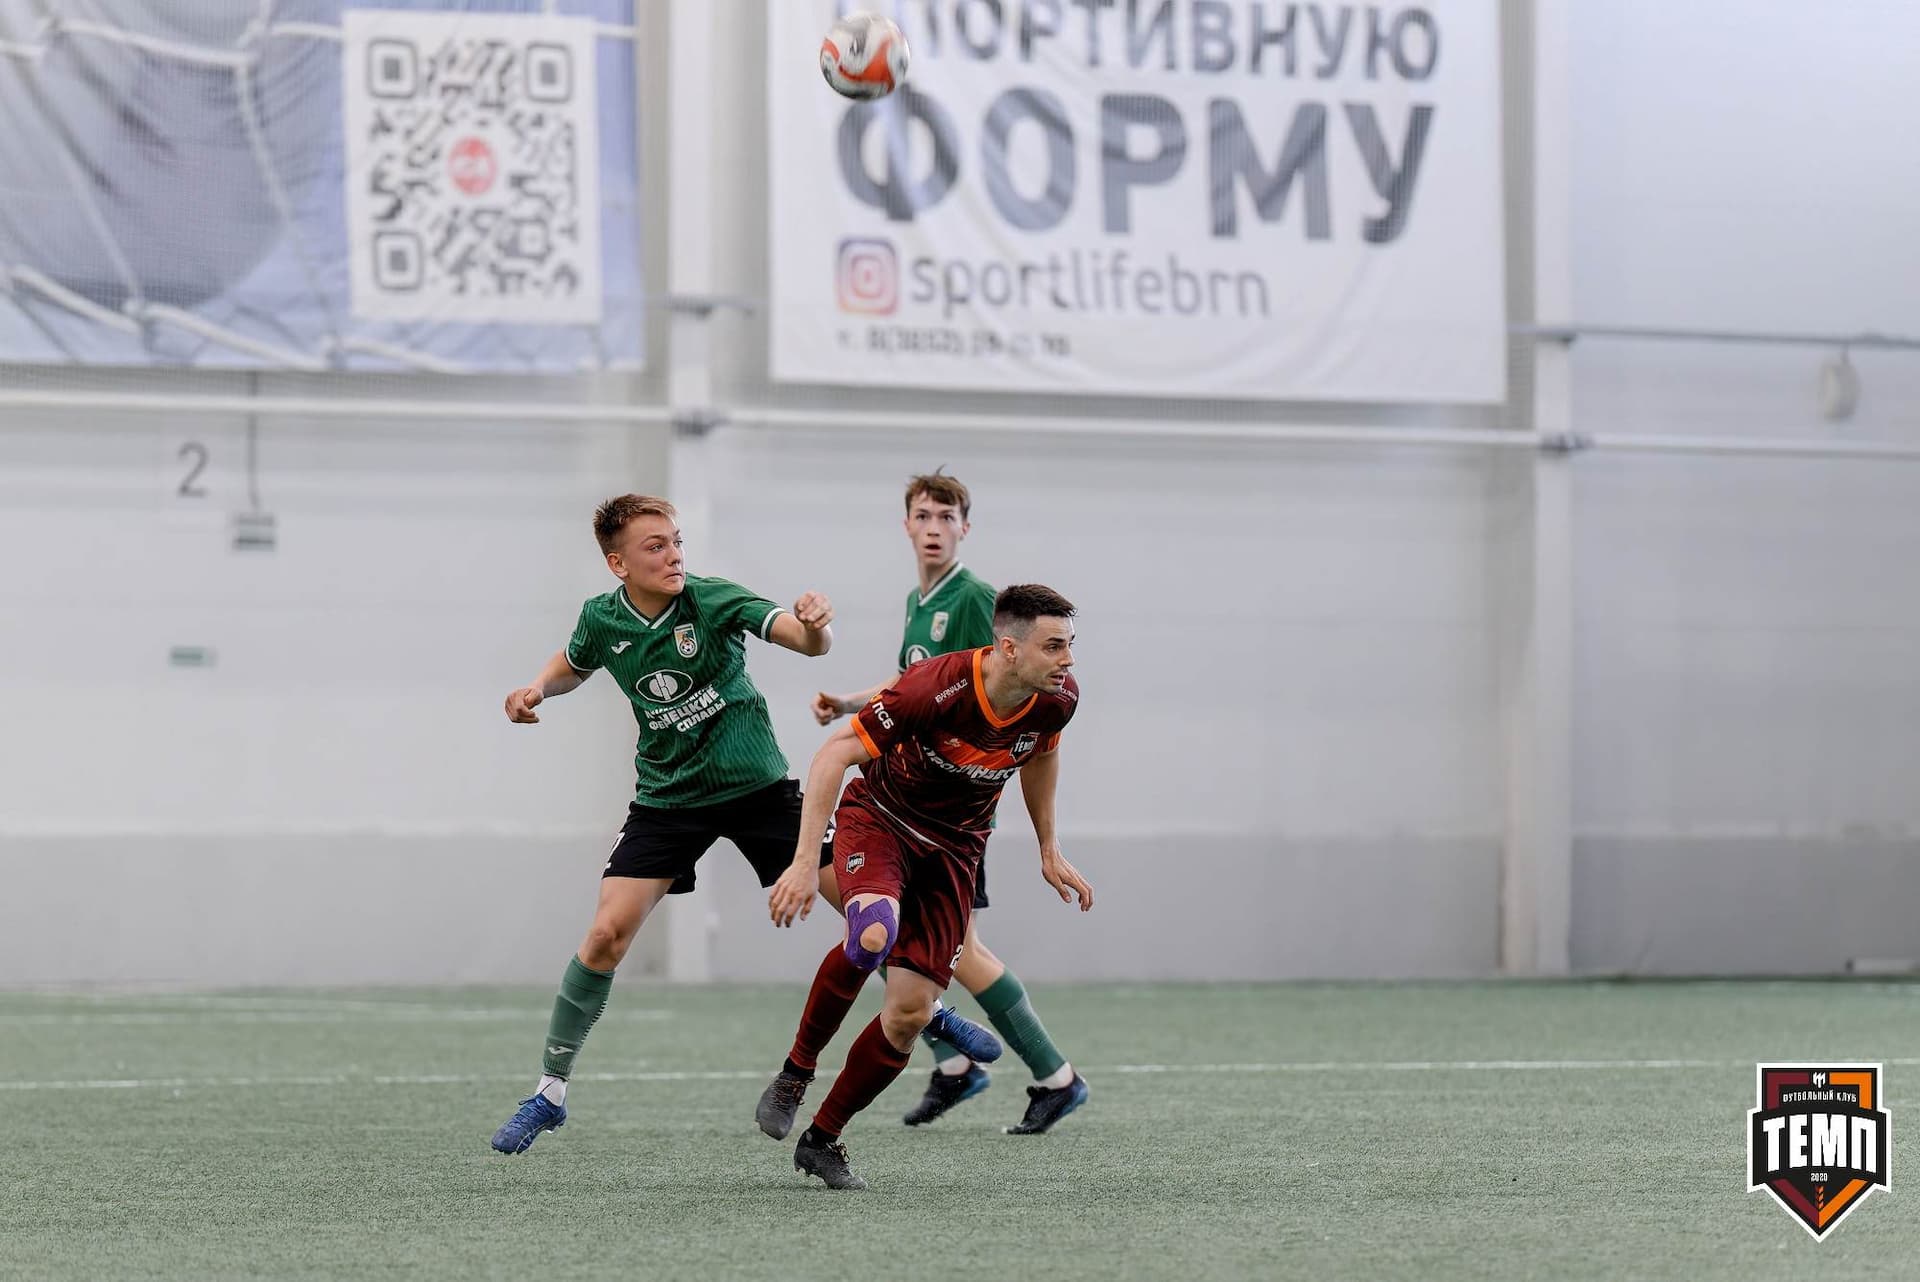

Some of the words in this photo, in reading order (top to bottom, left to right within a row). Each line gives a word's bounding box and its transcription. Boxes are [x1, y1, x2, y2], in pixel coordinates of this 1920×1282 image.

[836, 0, 1440, 80] ОРТИВНУЮ
[836, 82, 1435, 244] ФОРМУ
[911, 248, 1270, 318] sportlifebrn
[177, 440, 211, 499] 2
[871, 701, 895, 730] ПСБ
